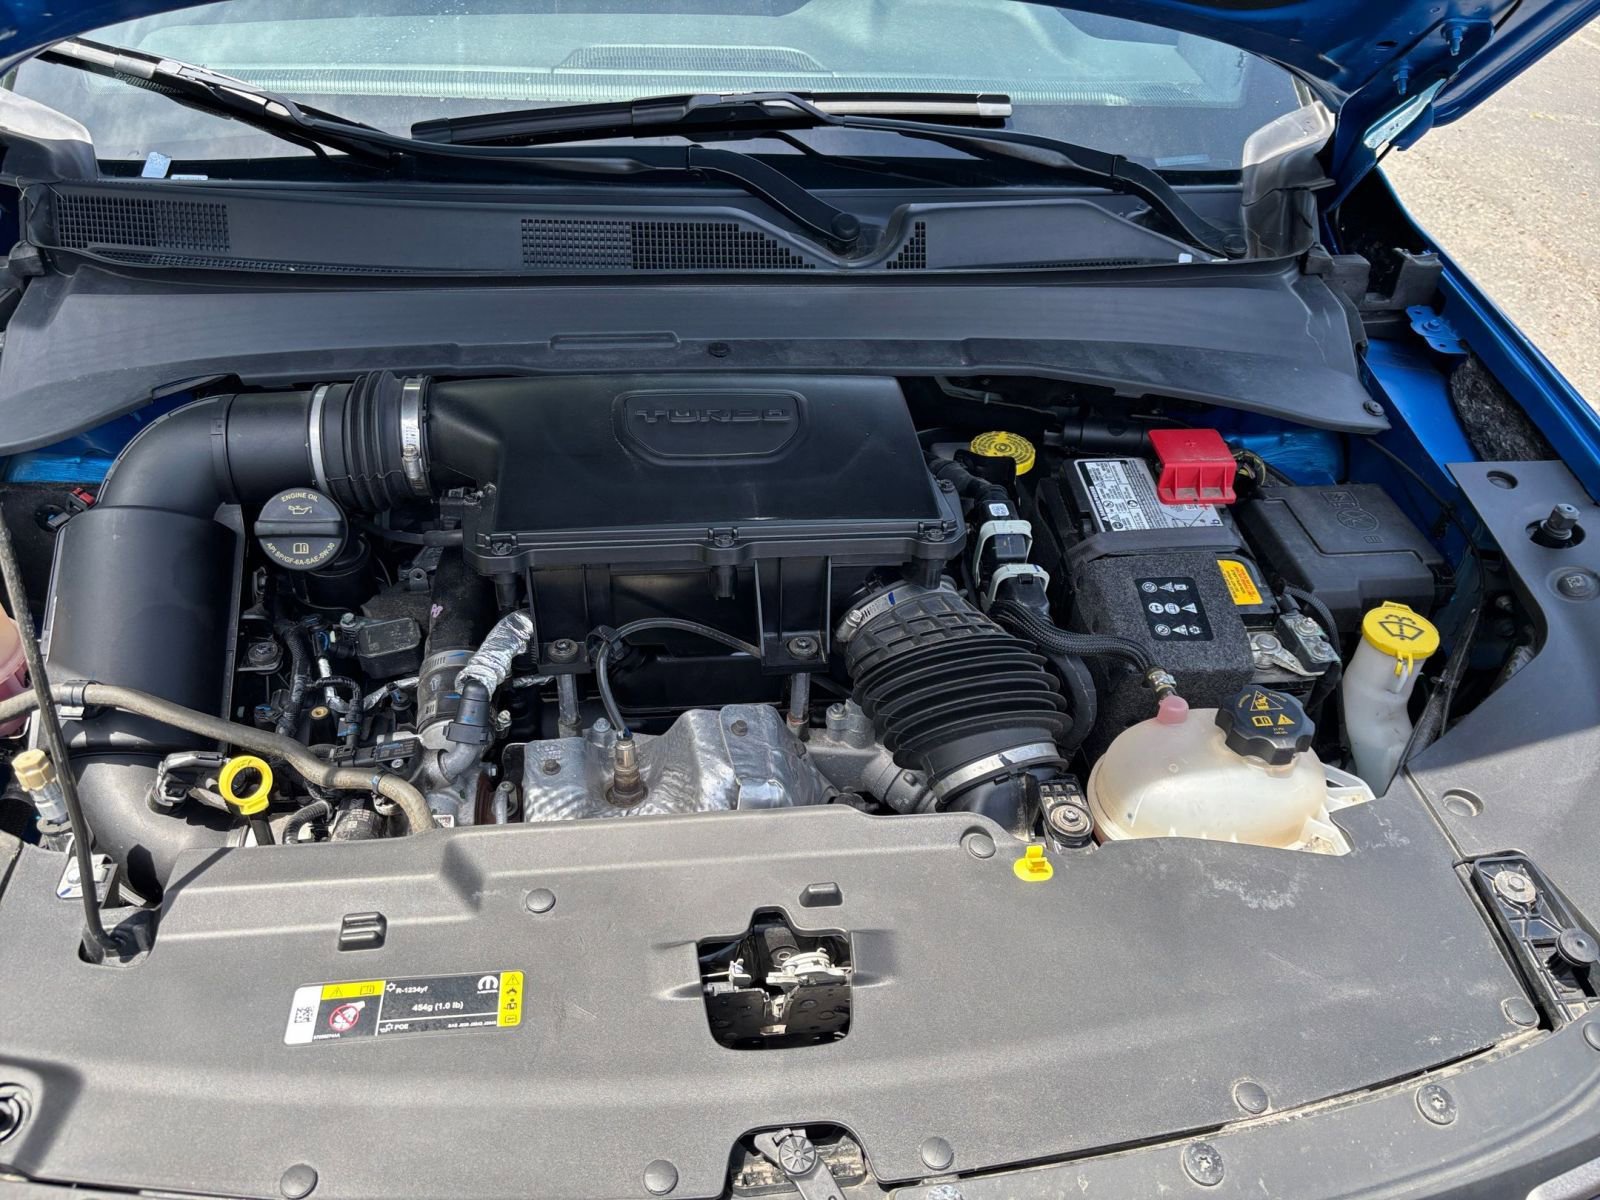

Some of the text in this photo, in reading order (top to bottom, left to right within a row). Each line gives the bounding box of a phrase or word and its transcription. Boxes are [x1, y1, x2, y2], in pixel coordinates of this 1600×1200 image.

[635, 409, 792, 424] TURBO
[281, 492, 318, 503] ENGINE OIL
[267, 543, 277, 553] API
[396, 986, 428, 994] R-1234yf
[412, 1001, 463, 1012] 454g (1.0 lb)
